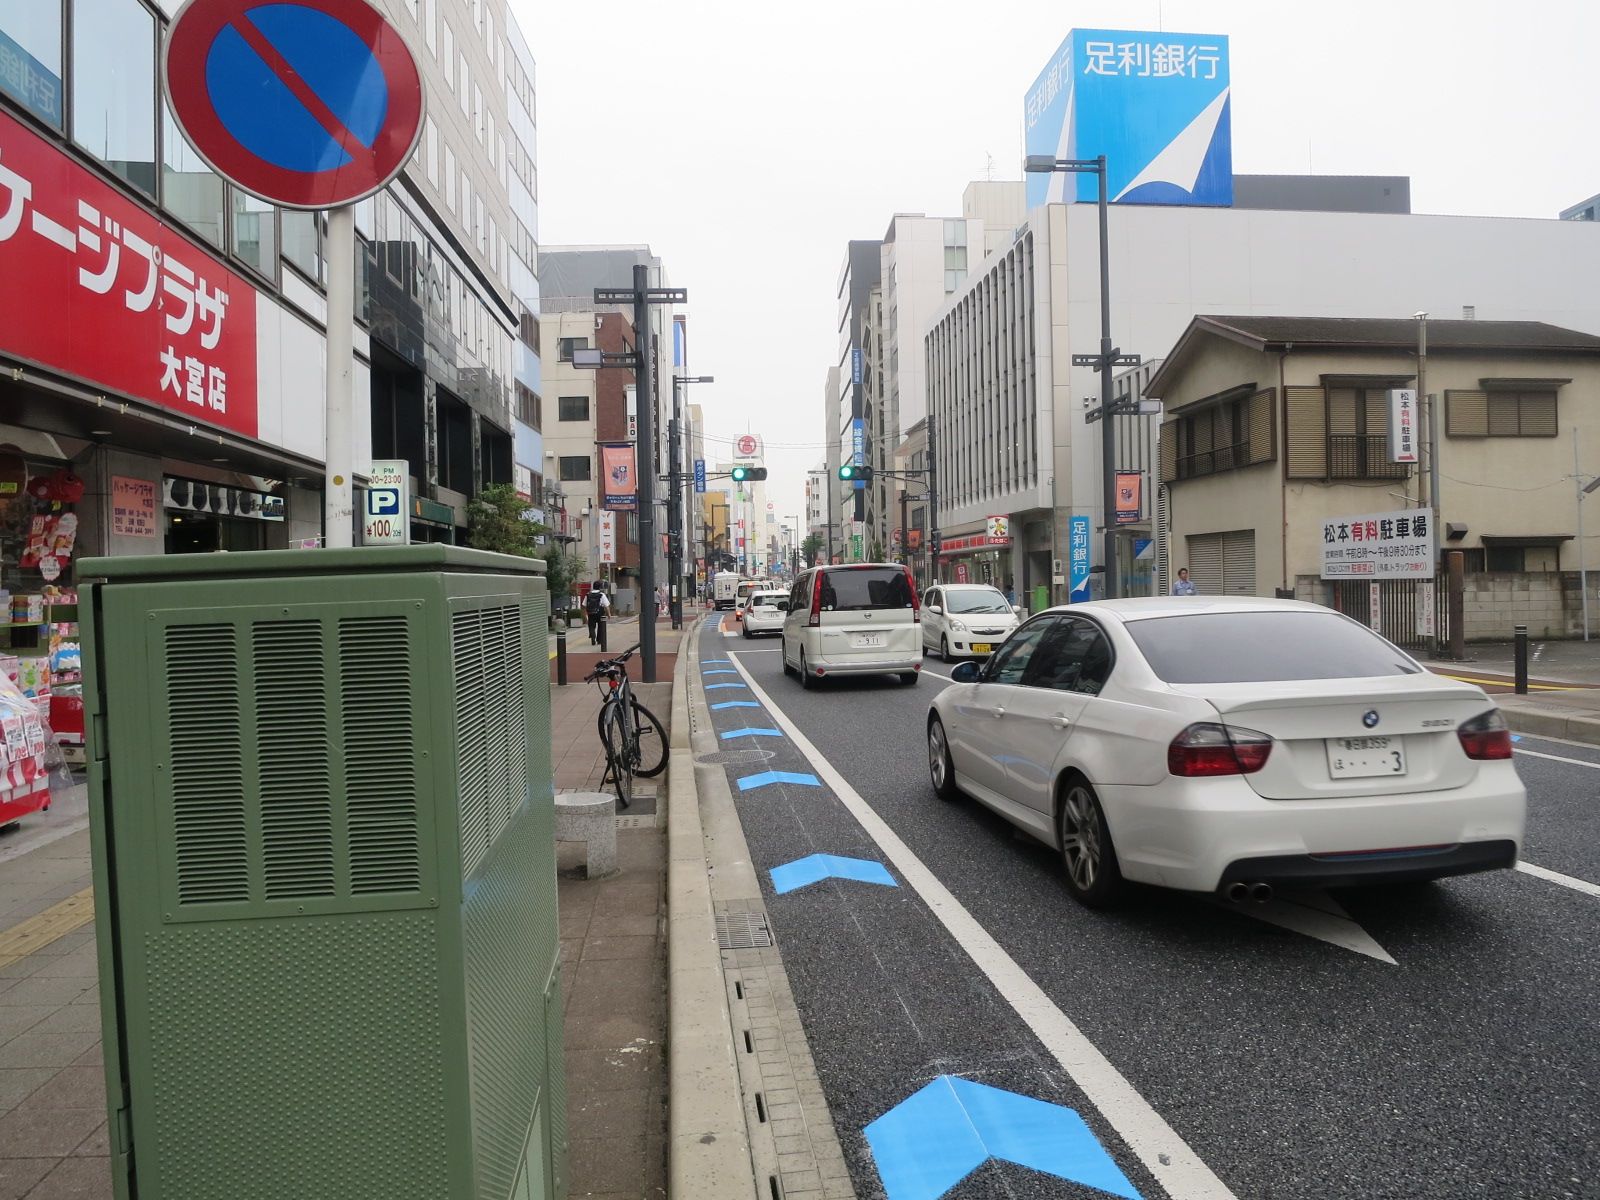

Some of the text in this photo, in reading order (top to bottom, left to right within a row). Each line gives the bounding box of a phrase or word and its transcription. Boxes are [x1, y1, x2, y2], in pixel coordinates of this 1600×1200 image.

[1084, 41, 1220, 80] 足利銀行
[1028, 47, 1070, 131] 足利銀行
[160, 345, 226, 415] 大宮店
[1400, 392, 1411, 452] 松本有料駐車場
[371, 491, 397, 514] P
[1324, 515, 1427, 543] 松本有料駐車場
[1073, 521, 1087, 574] 足利銀行
